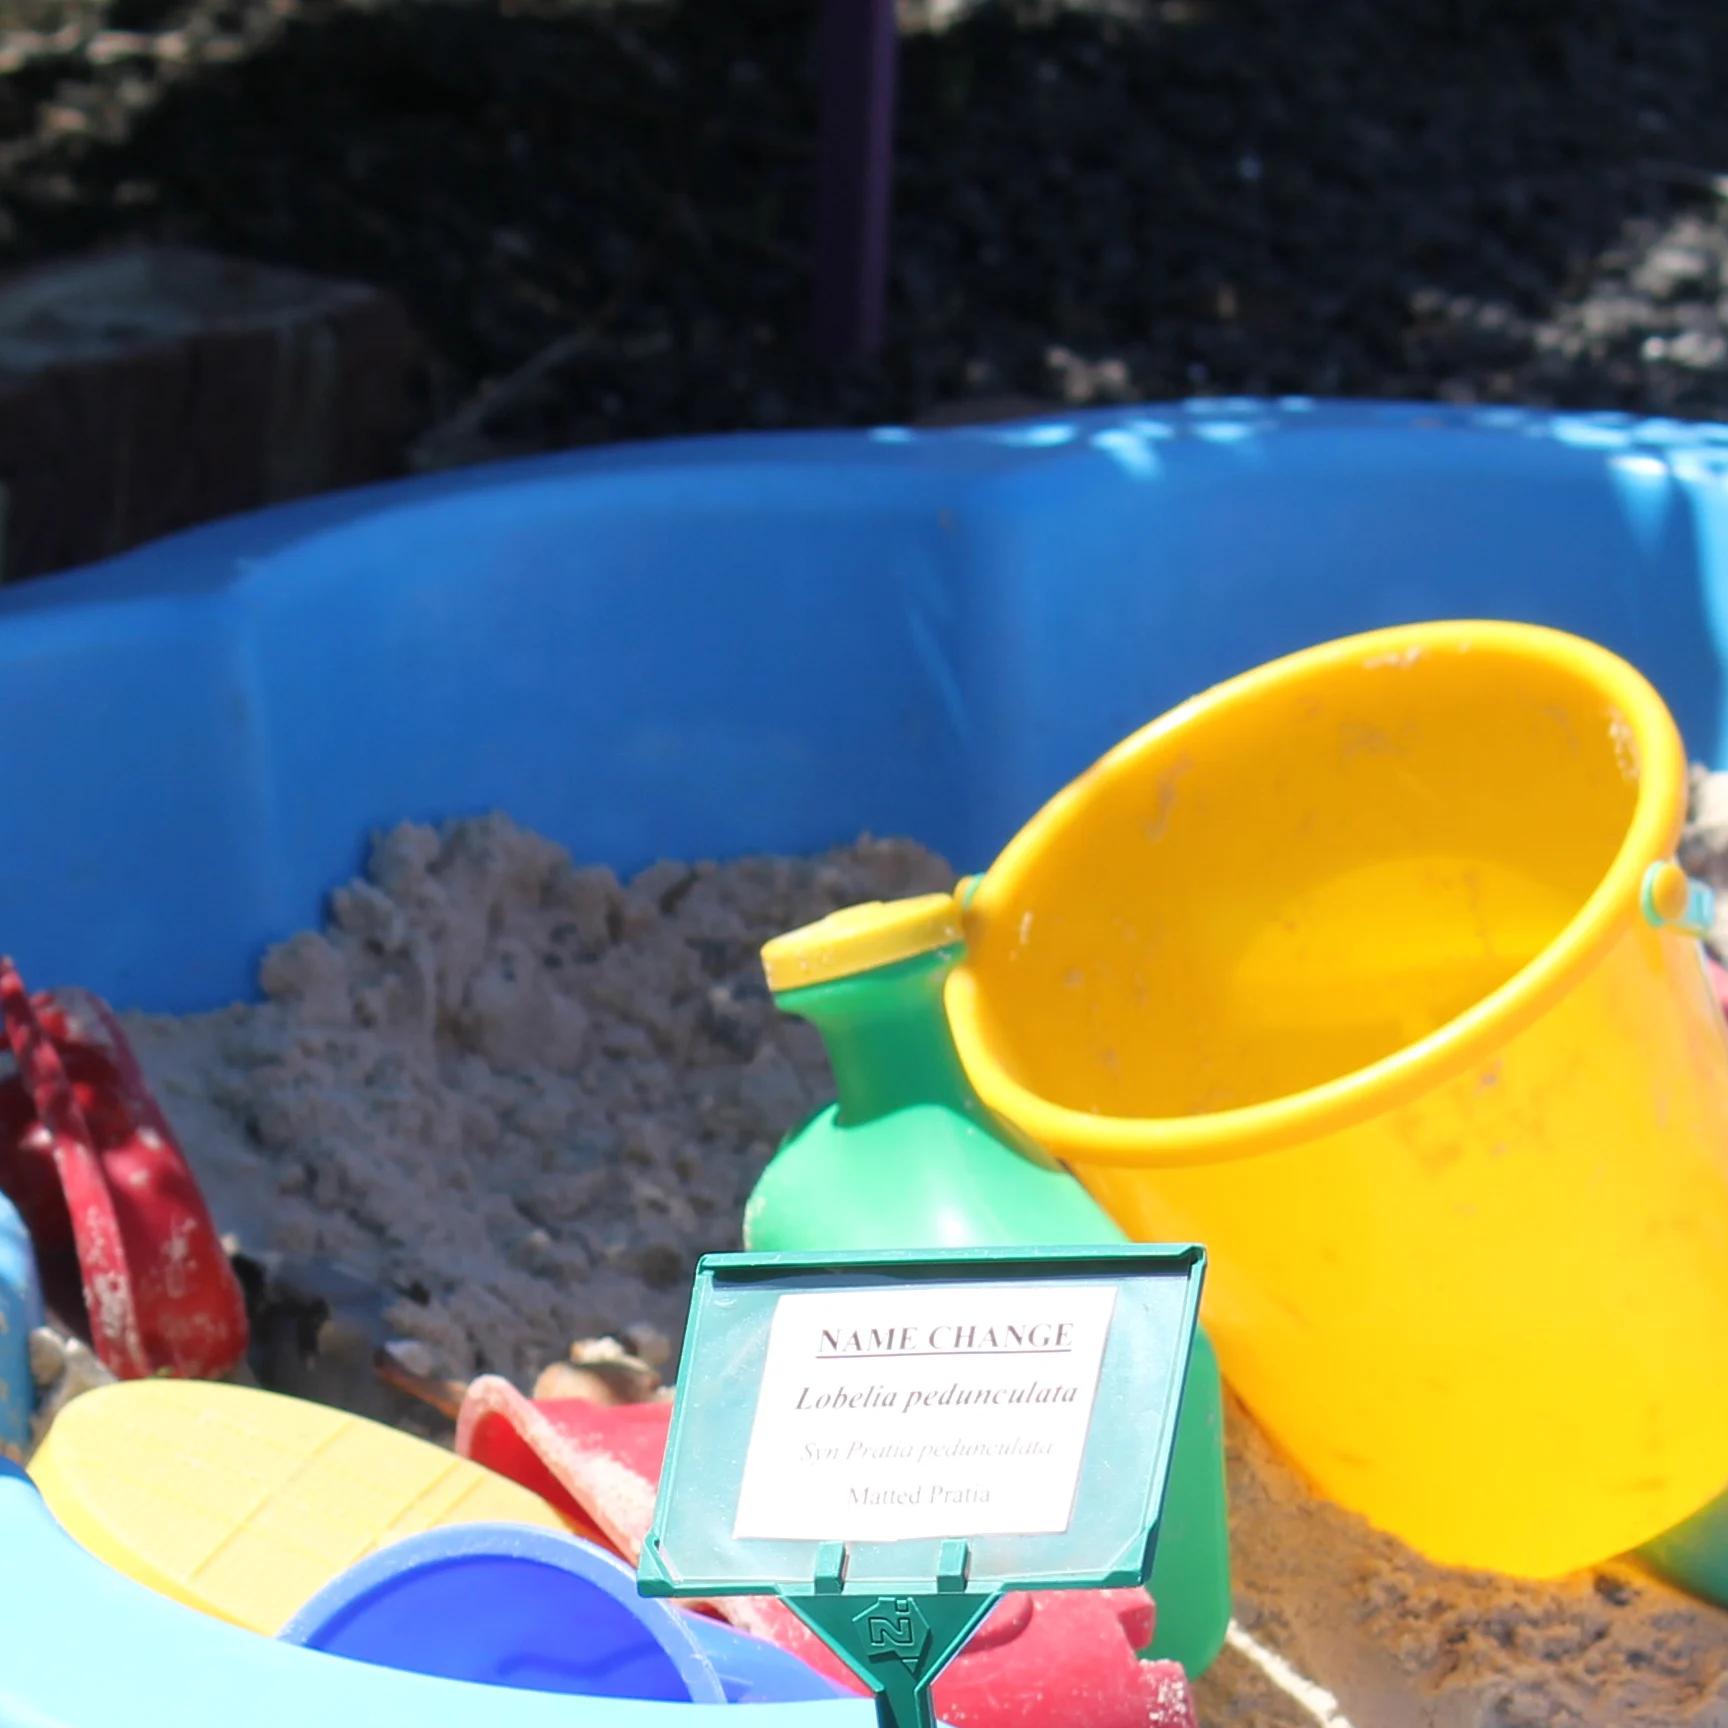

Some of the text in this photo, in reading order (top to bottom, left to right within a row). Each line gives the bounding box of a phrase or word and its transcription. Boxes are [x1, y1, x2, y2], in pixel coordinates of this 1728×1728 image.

[818, 1322, 1075, 1352] NAME CHANGE
[794, 1380, 1079, 1414] Lobelia pedunculata
[799, 1437, 1054, 1466] Syn Pratia pedunculata
[847, 1483, 992, 1506] Matted Pratia
